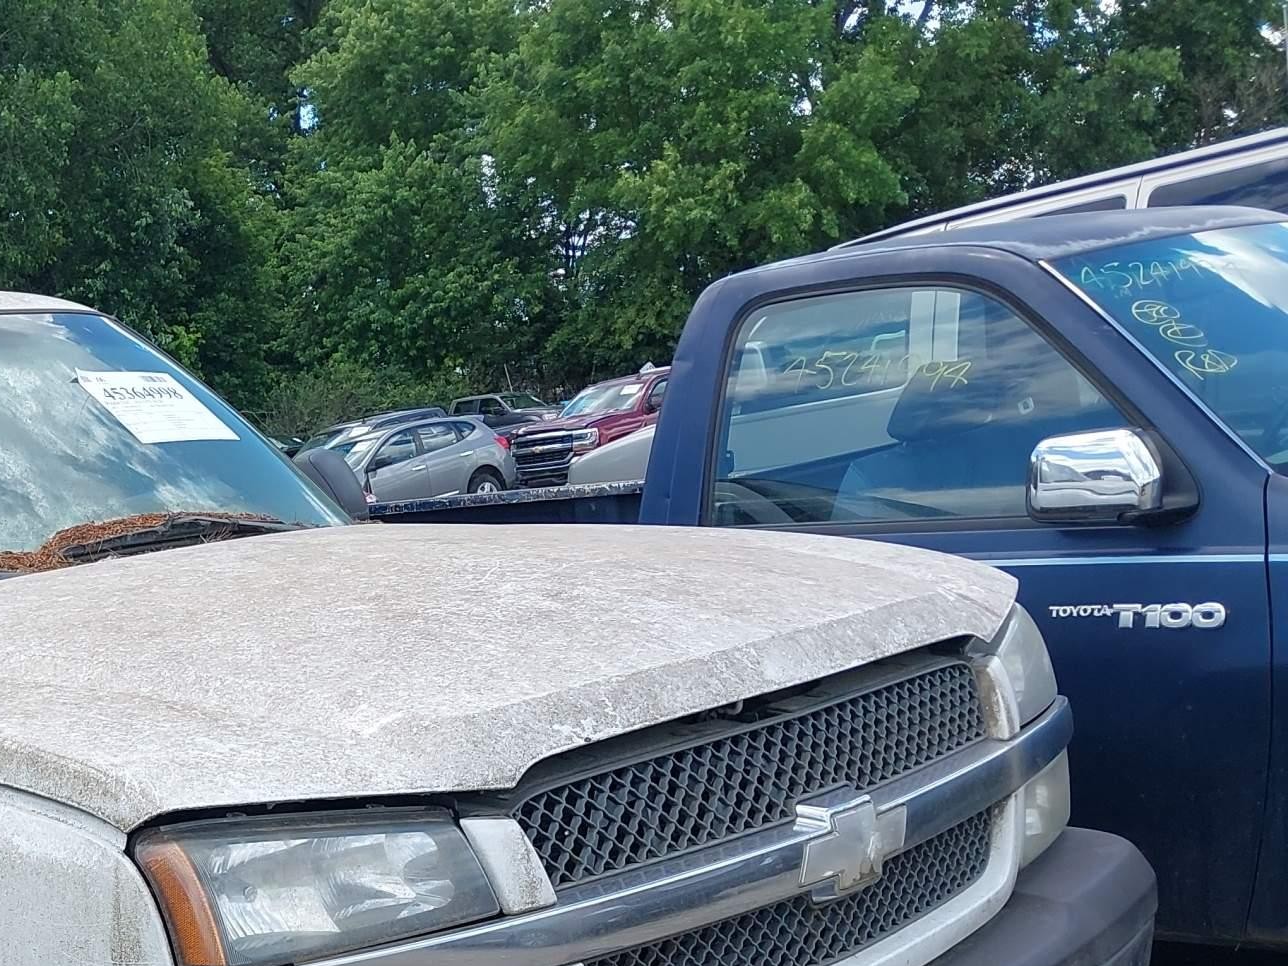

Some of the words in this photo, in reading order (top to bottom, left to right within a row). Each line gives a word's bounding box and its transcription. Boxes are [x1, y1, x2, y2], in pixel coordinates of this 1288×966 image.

[103, 386, 184, 401] 45364998
[1048, 604, 1113, 618] TOYOTA
[1112, 601, 1227, 629] T100
